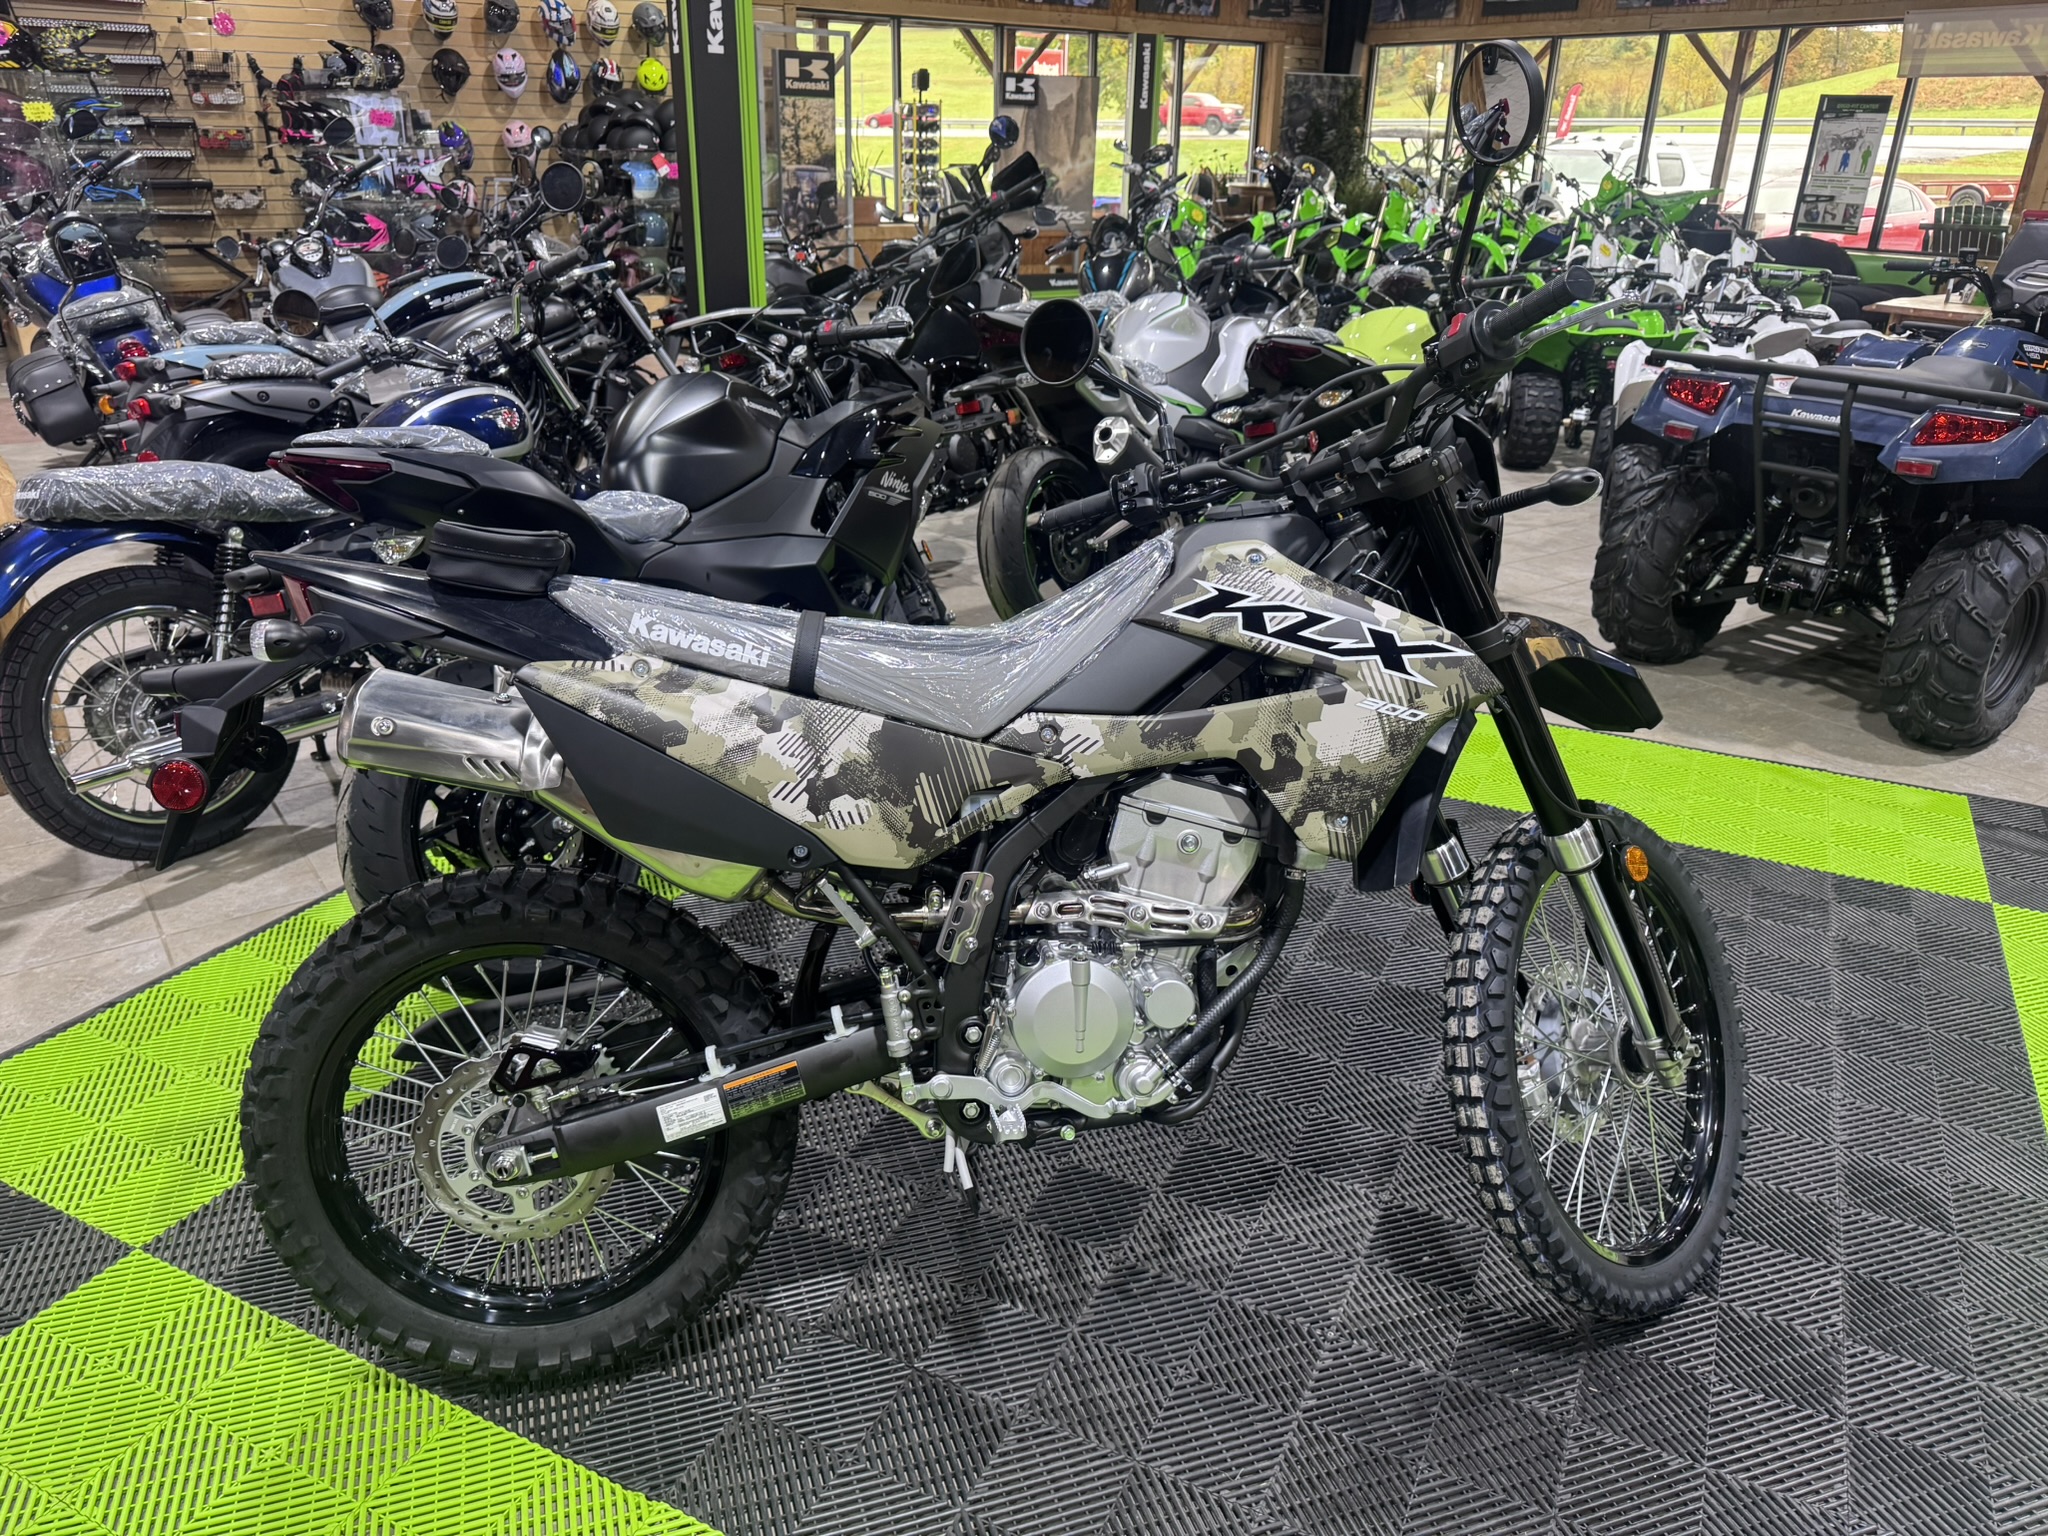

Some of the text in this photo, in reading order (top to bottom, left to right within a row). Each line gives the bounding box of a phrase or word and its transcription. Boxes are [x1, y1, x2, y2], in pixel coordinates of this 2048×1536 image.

[785, 79, 830, 91] Kawasaki
[1139, 42, 1152, 109] Kawasaki
[1005, 92, 1035, 101] Kawasaki
[1790, 408, 1842, 424] Kawasak
[880, 470, 911, 494] Ninja
[628, 611, 772, 668] Kawasaki
[1160, 578, 1475, 688] KLX
[1356, 696, 1430, 722] 300
